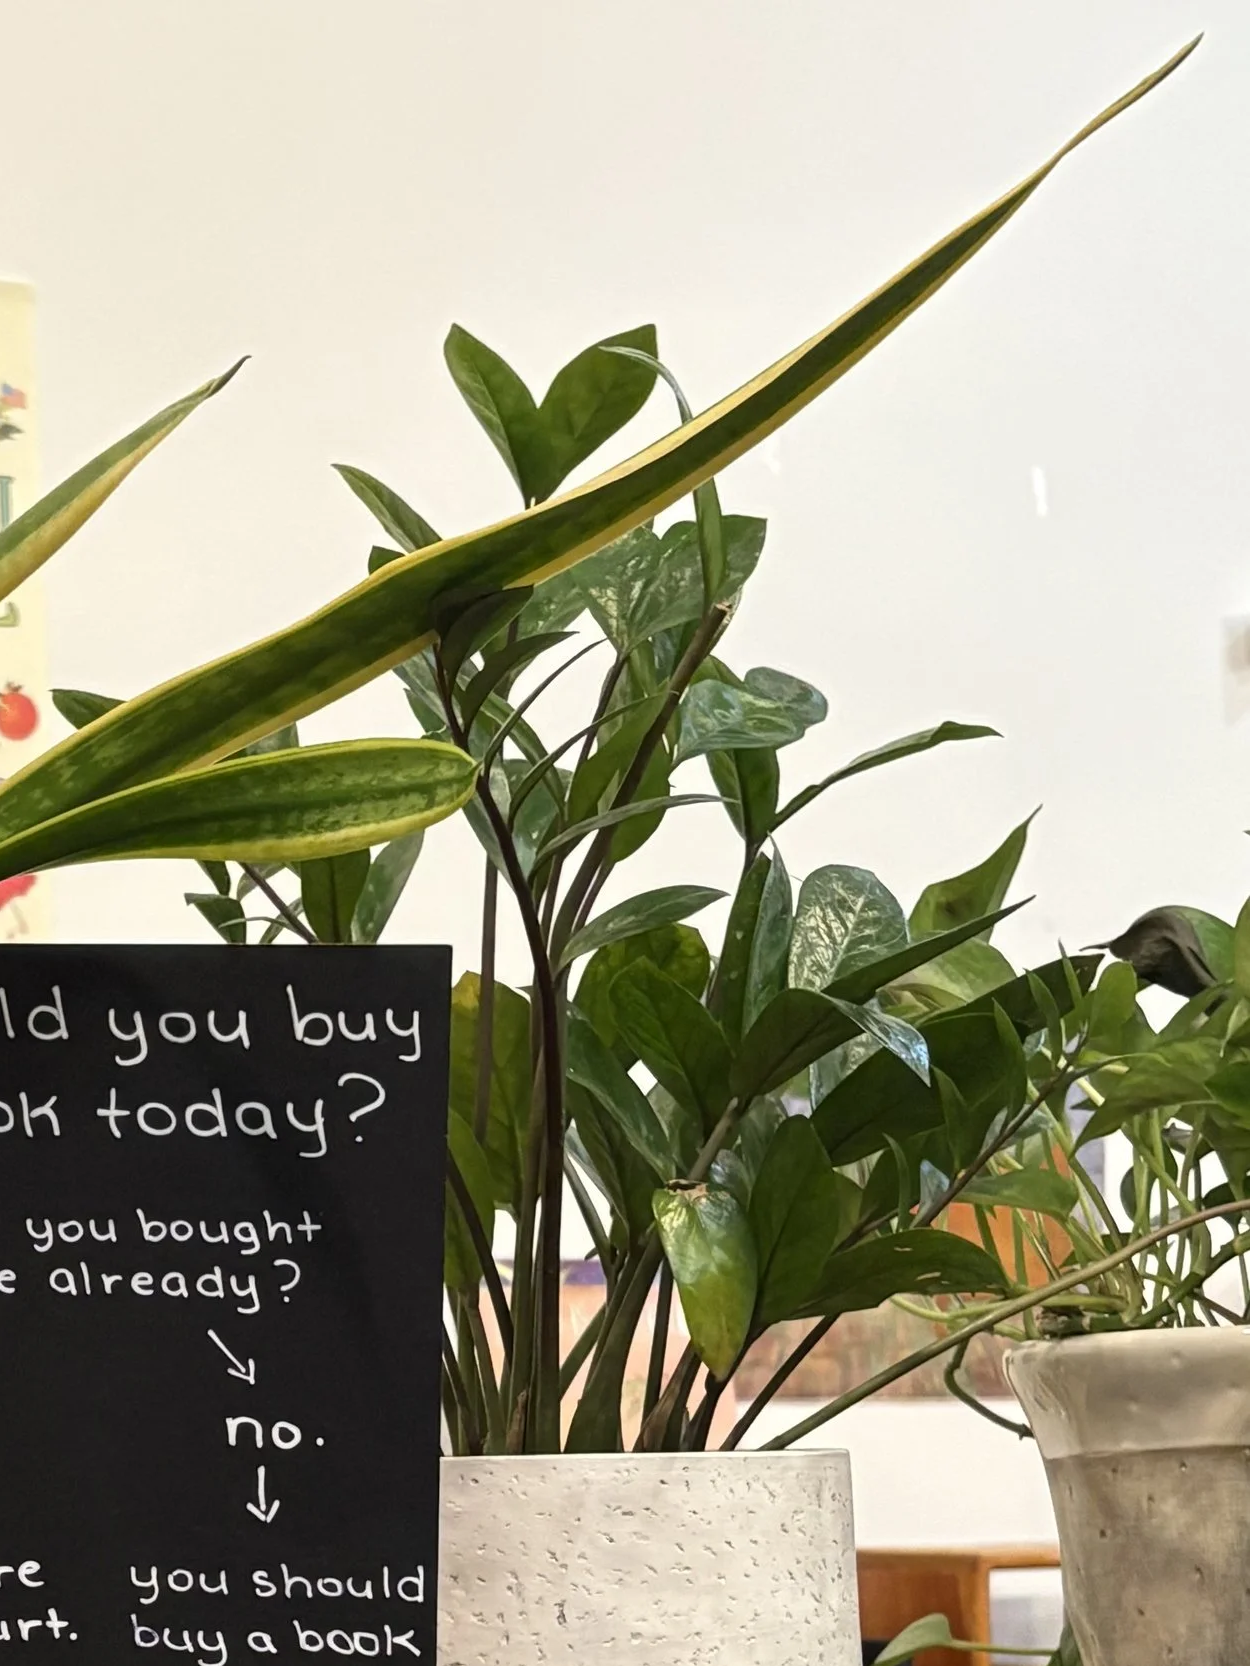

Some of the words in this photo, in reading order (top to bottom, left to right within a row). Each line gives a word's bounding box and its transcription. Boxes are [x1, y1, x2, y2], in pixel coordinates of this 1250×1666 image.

[108, 1008, 250, 1066] you
[286, 984, 421, 1062] buy
[97, 1072, 386, 1158] today?
[26, 1217, 118, 1252] you
[136, 1208, 322, 1255] bought
[49, 1259, 301, 1314] already?
[226, 1416, 325, 1450] no.
[130, 1565, 229, 1605] you
[252, 1563, 424, 1603] should
[247, 1631, 278, 1654] a
[293, 1620, 421, 1657] book
